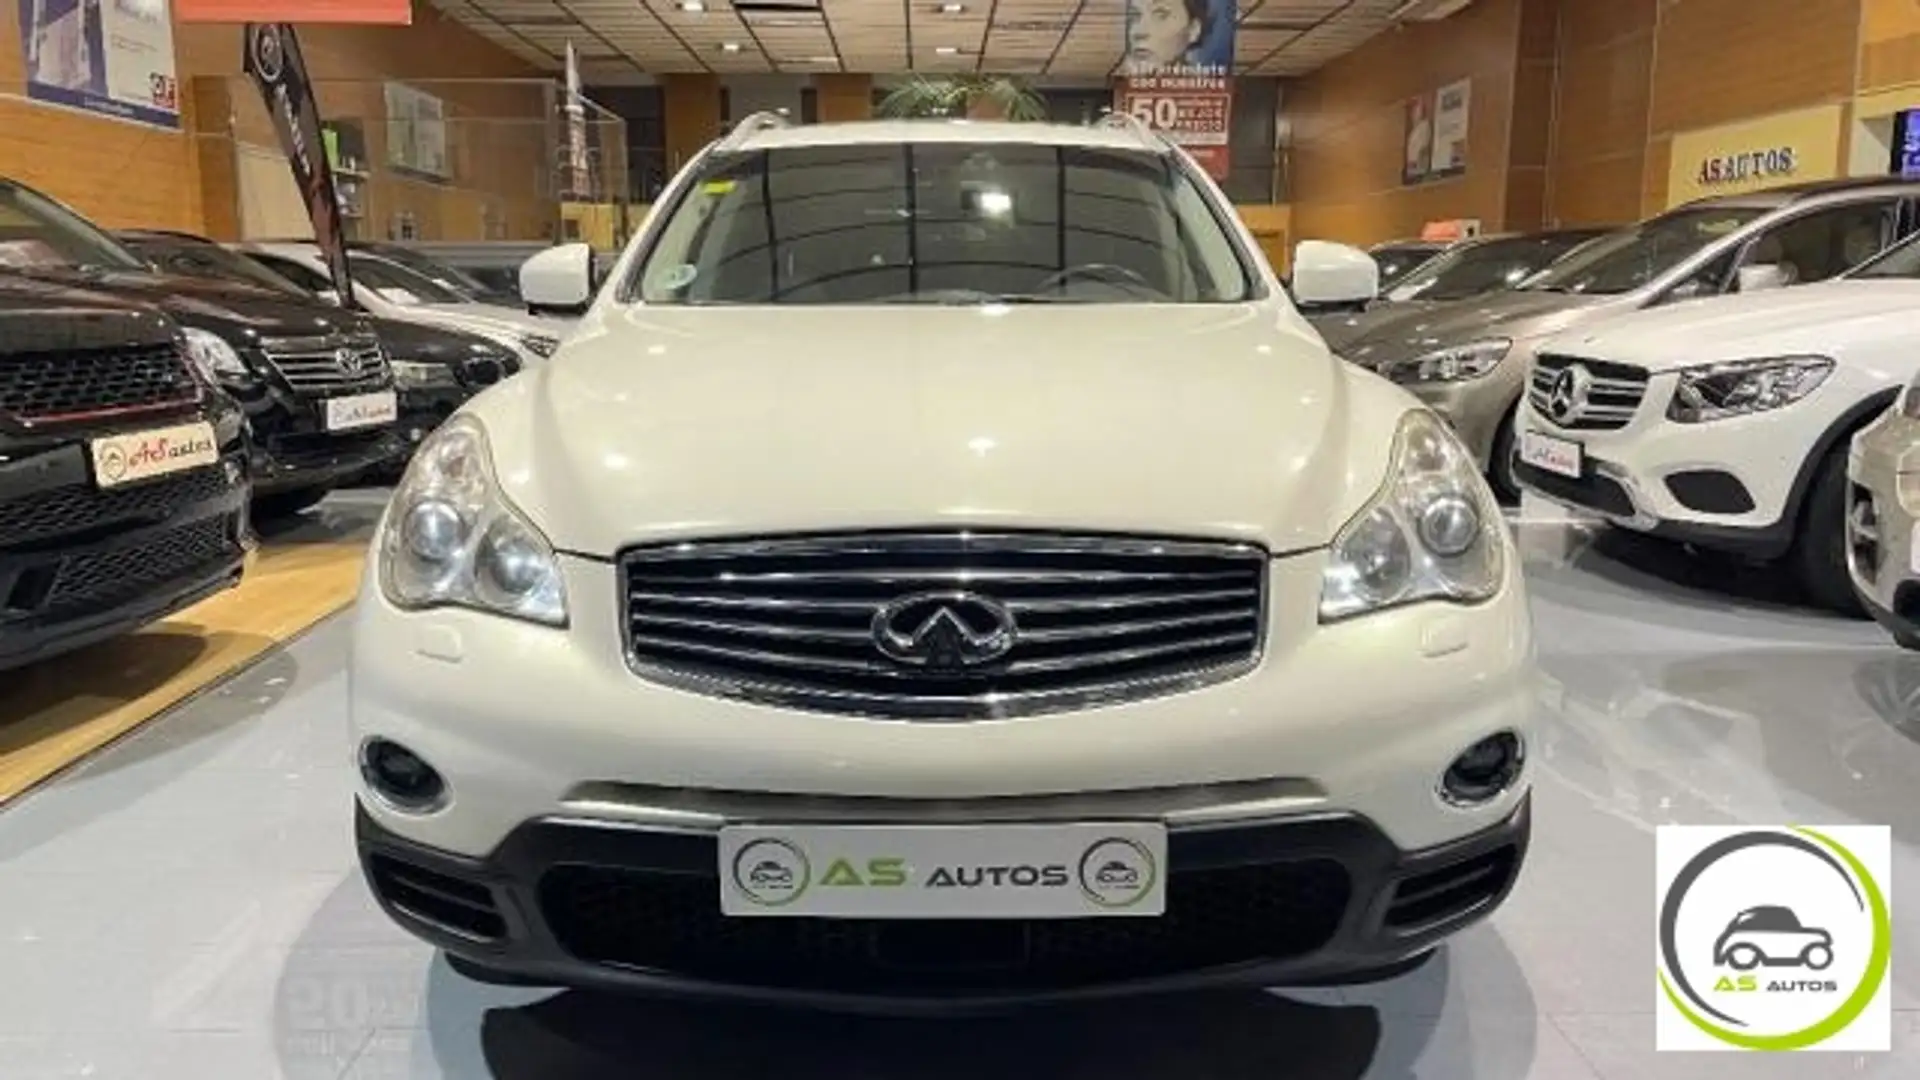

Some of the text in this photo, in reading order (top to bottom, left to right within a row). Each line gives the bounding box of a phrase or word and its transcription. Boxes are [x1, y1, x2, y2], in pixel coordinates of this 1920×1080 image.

[1132, 97, 1178, 129] 50
[819, 857, 1069, 888] AS AUTOS
